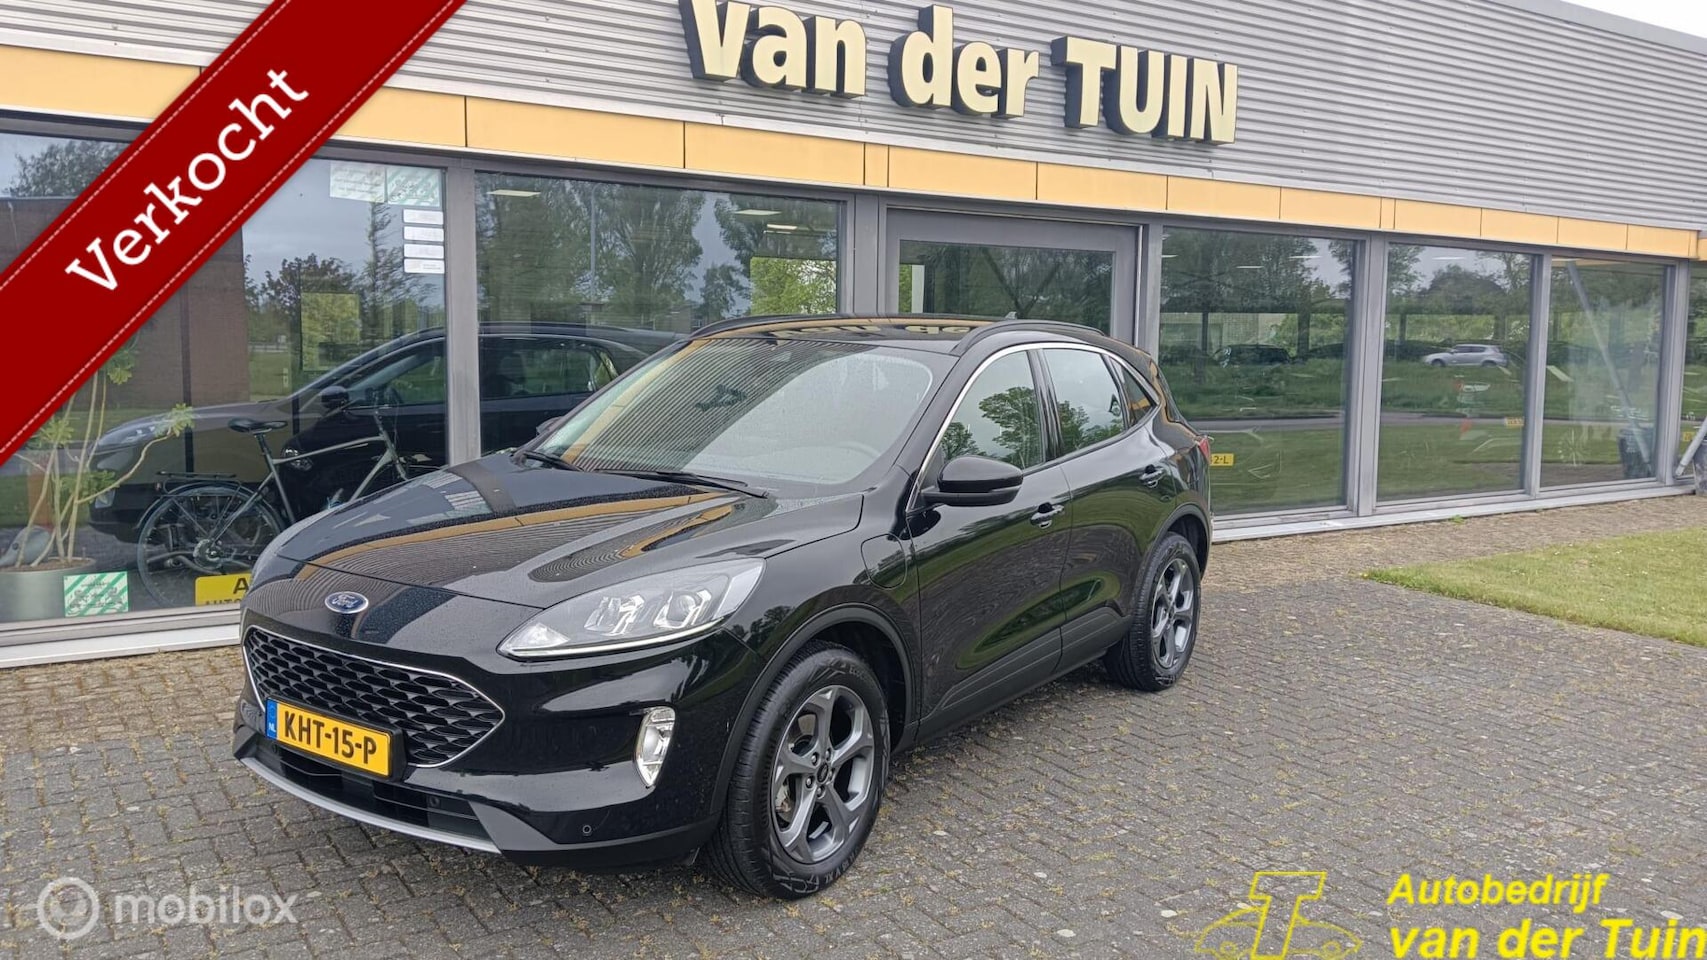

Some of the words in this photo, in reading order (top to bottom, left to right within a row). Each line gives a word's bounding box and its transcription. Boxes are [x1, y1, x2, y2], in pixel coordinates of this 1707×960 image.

[895, 4, 1040, 117] der
[1057, 36, 1238, 144] TUIN
[330, 593, 363, 609] Ford
[268, 722, 277, 733] NL
[284, 710, 377, 765] KHT-15-P
